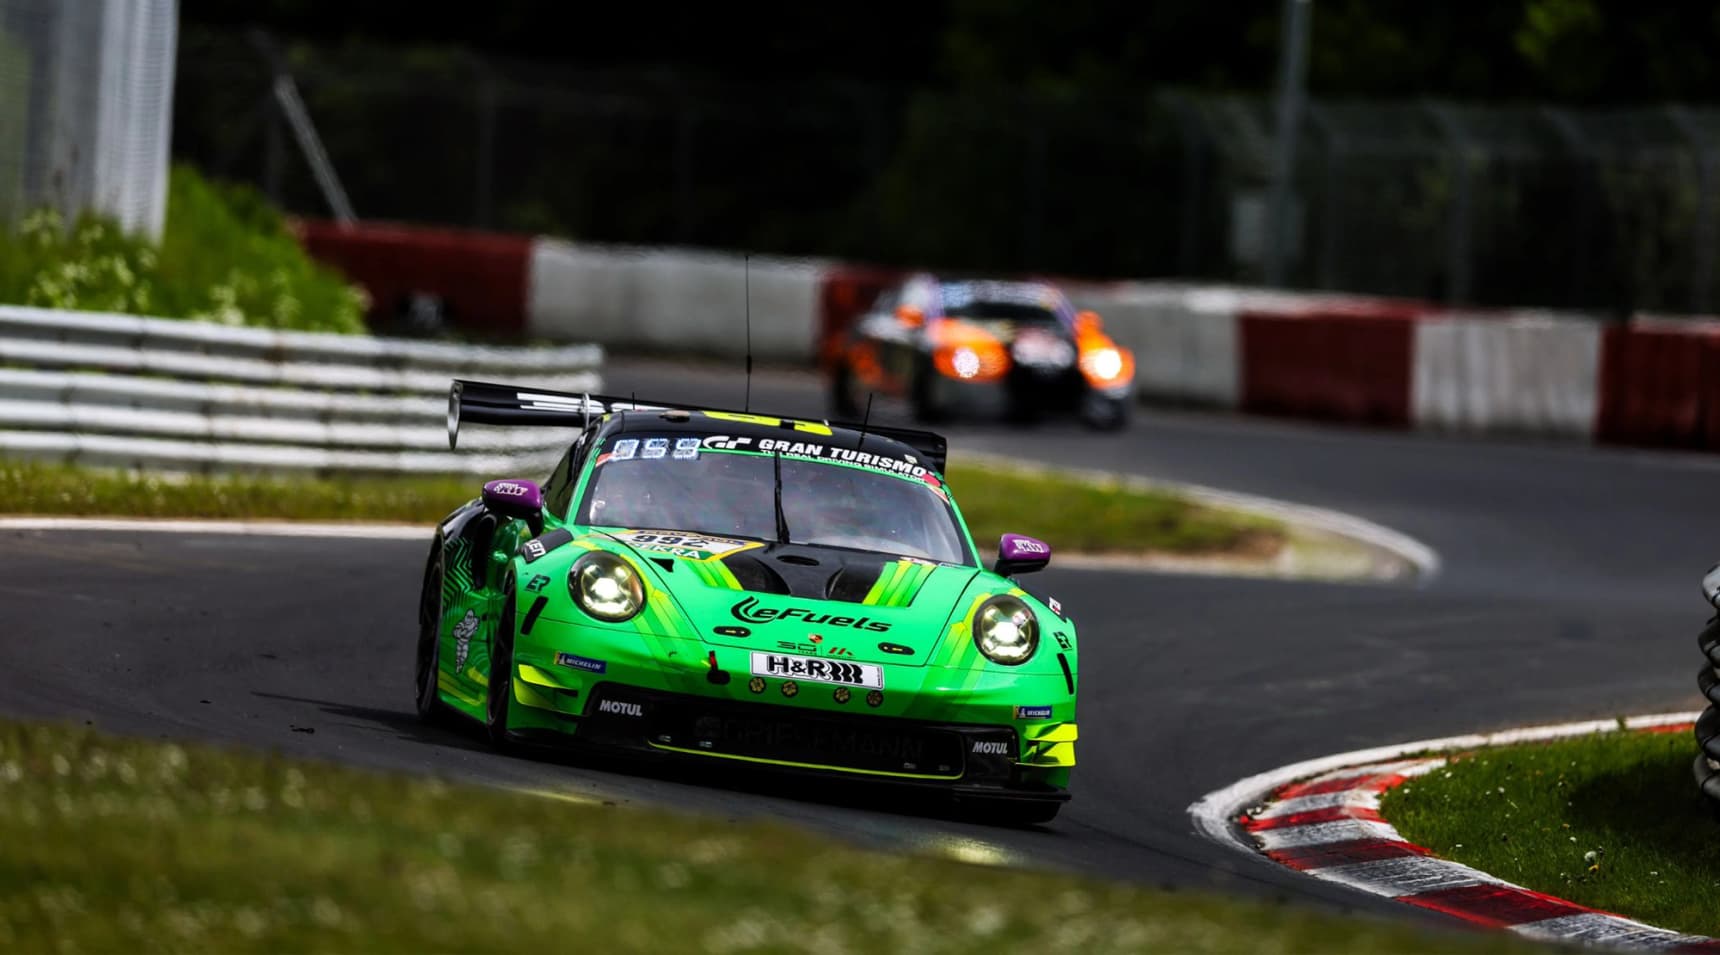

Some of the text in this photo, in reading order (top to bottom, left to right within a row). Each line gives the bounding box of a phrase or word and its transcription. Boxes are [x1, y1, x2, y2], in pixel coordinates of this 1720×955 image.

[758, 439, 927, 477] GRAN TURISMO
[631, 535, 710, 547] 992
[751, 606, 892, 633] eFuels
[566, 658, 602, 670] MICHELIN
[599, 699, 643, 717] MOTUL
[972, 741, 1009, 754] MOTUL
